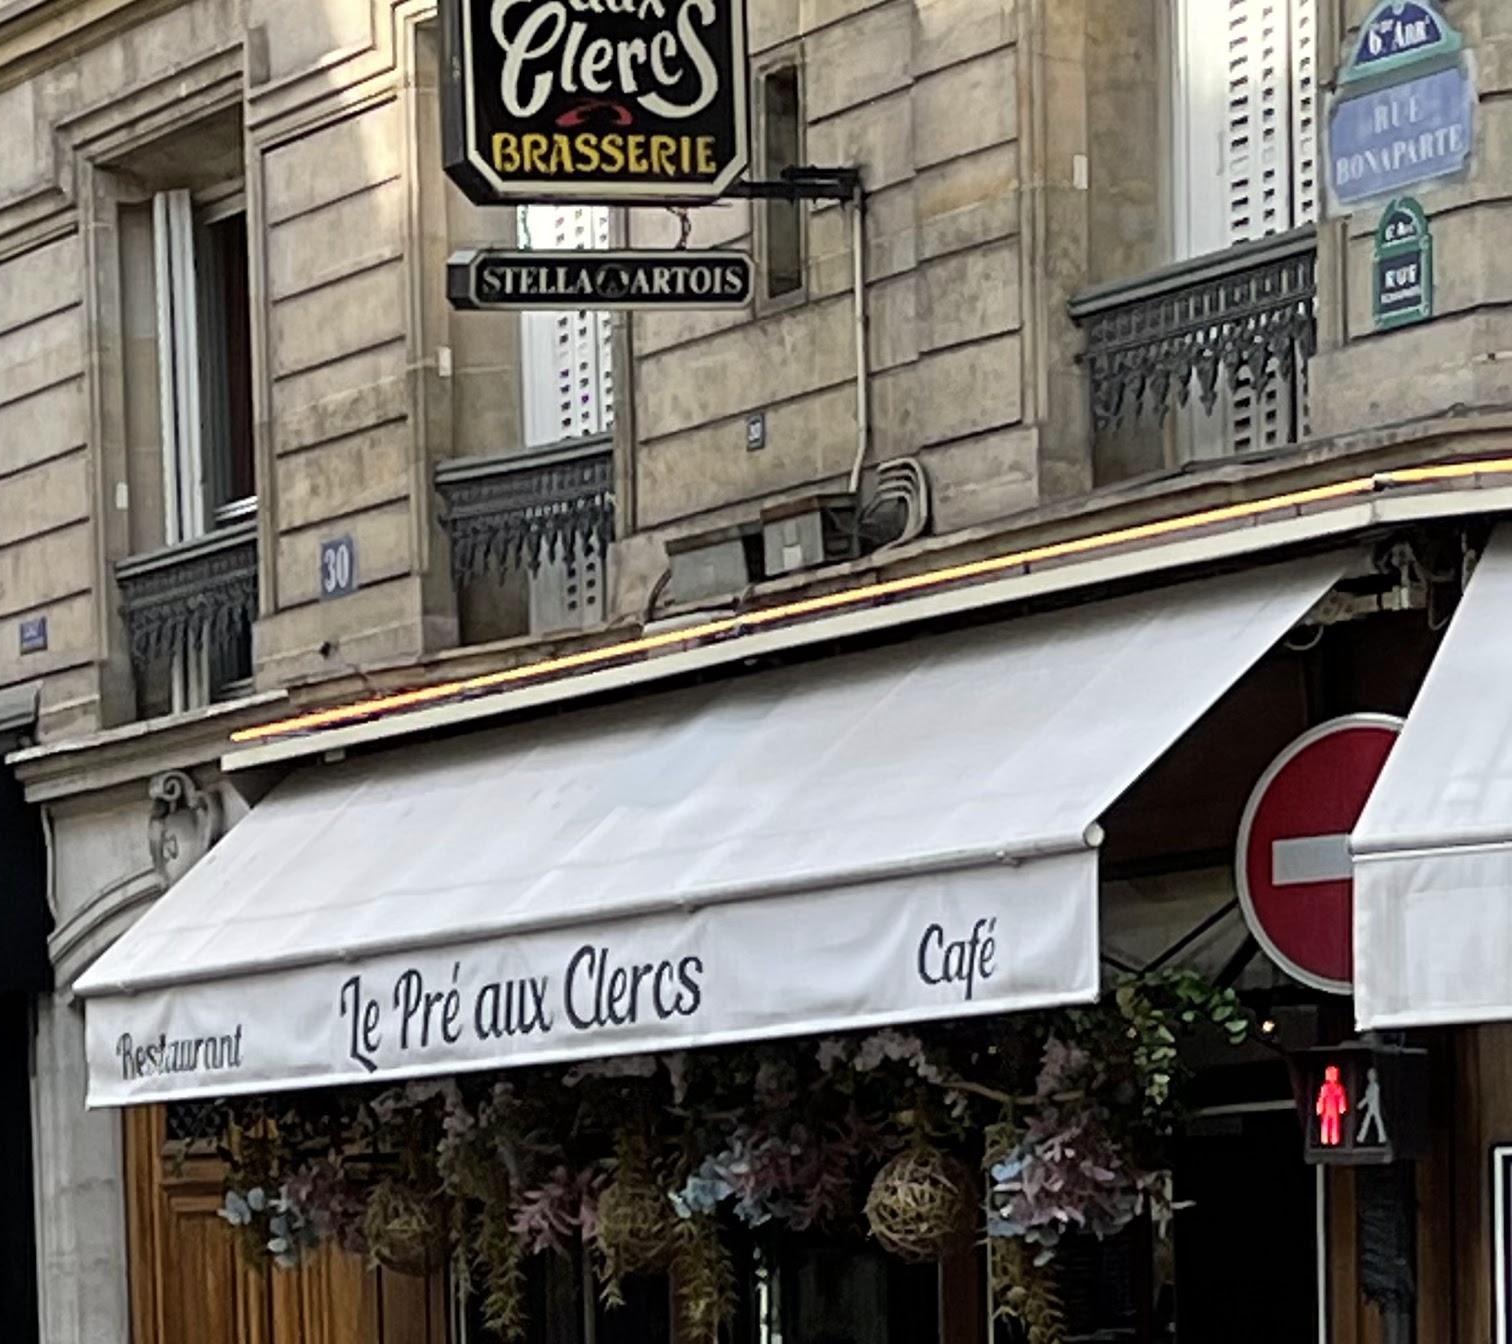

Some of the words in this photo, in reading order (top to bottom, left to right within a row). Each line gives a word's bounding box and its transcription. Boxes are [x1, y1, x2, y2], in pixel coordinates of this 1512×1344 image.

[1374, 96, 1424, 133] RUE
[492, 132, 717, 175] BRASSERIE
[1335, 123, 1463, 186] BONAPARTE
[482, 265, 593, 296] STELLA
[629, 265, 744, 295] ARTOIS
[324, 544, 349, 593] 30
[917, 916, 997, 1001] Café
[340, 974, 381, 1074] Le
[393, 960, 463, 1050] Pré
[474, 976, 554, 1041] aux
[563, 944, 704, 1031] Clercs
[116, 1023, 244, 1081] Restaurant
